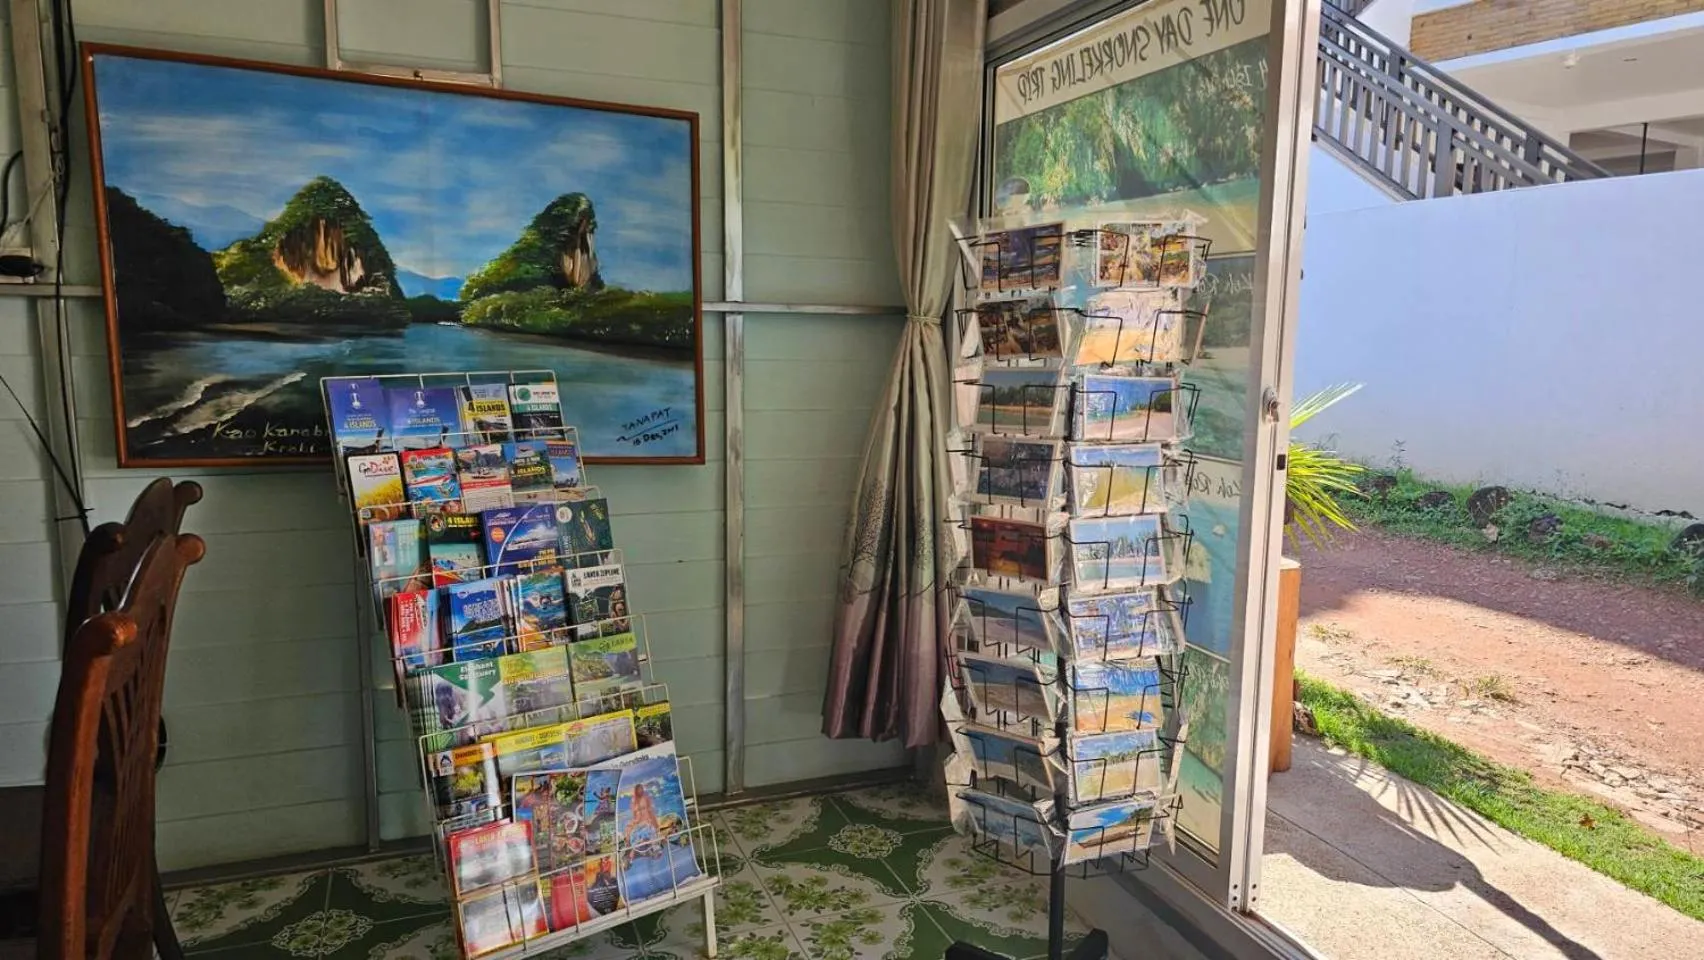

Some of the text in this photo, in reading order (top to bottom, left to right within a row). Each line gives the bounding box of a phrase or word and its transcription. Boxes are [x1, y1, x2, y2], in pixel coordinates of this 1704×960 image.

[468, 401, 506, 412] 4 ISLANDS
[211, 421, 257, 440] Kao
[517, 465, 546, 474] ISLANDS
